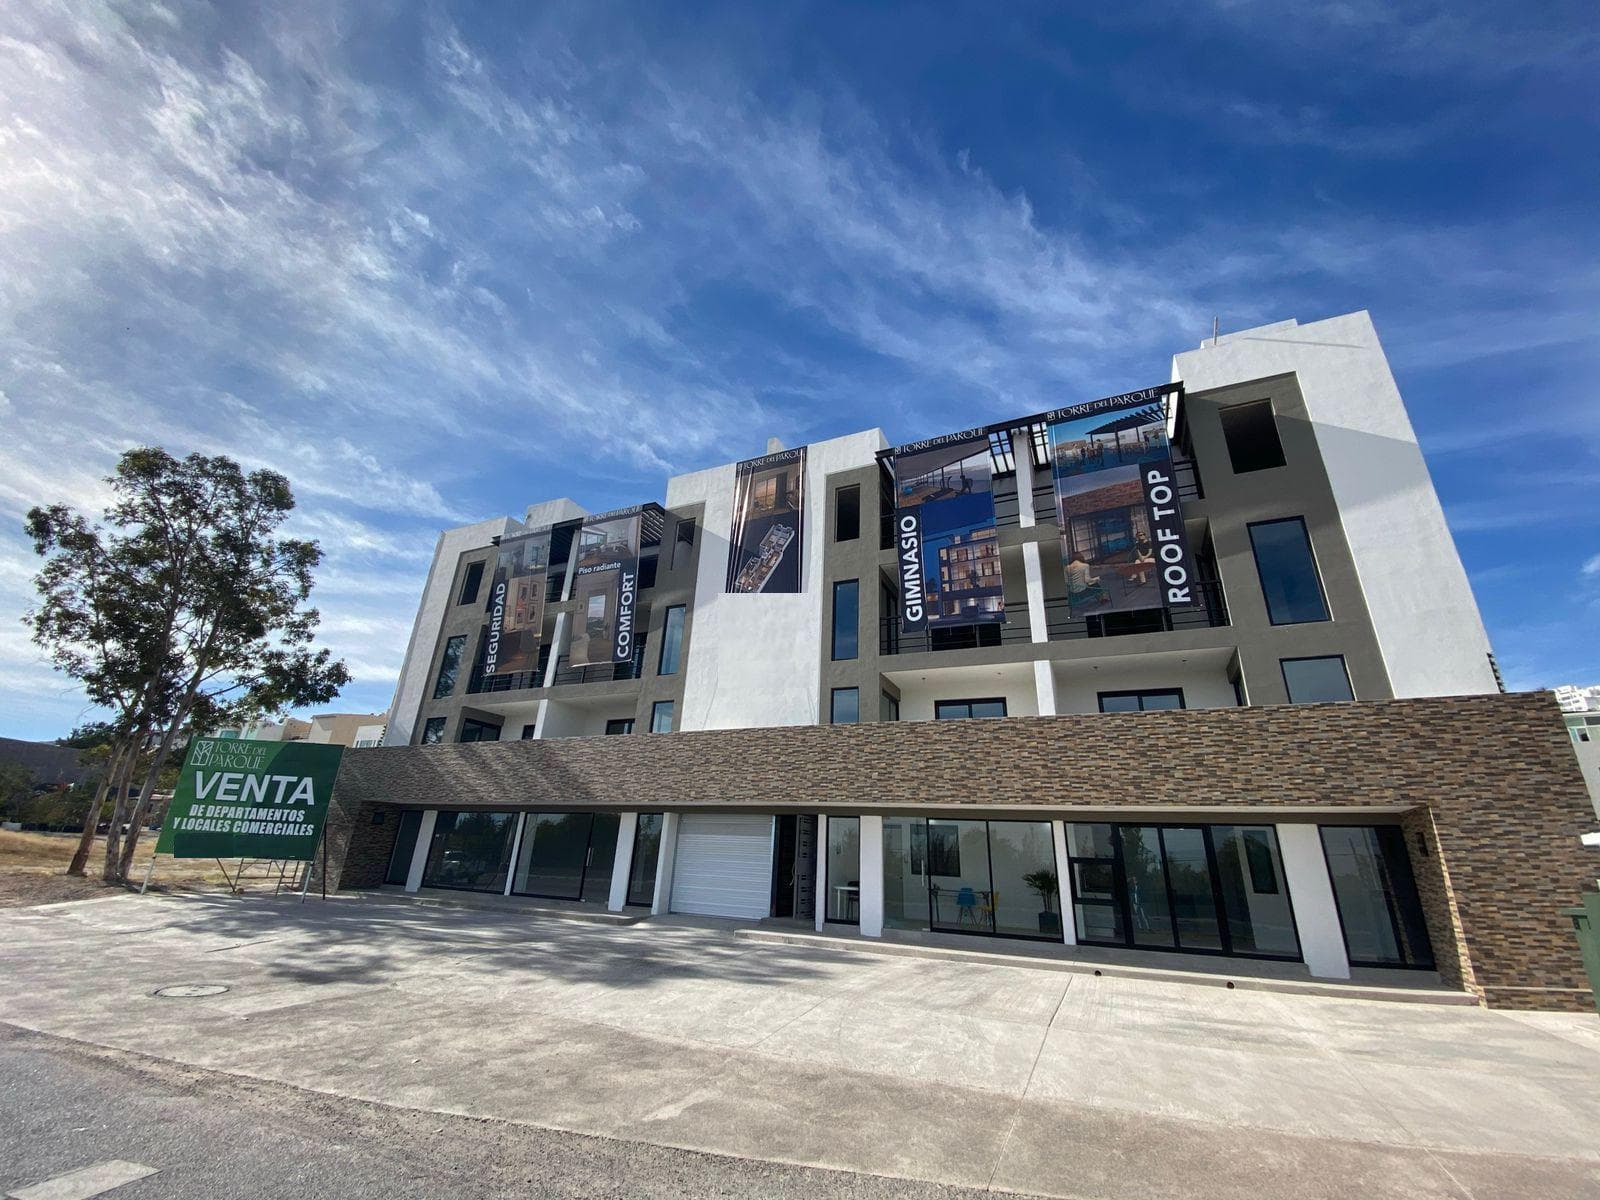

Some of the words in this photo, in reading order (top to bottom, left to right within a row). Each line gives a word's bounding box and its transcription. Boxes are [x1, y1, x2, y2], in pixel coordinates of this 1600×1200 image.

[1109, 387, 1159, 407] PARQUE
[1147, 469, 1175, 521] TOP
[578, 566, 592, 575] Piso
[593, 561, 621, 572] radiante
[900, 515, 923, 622] GIMNASIO
[1156, 528, 1192, 604] ROOF
[485, 582, 506, 674] SEGURIDAD
[617, 572, 634, 658] COMFORT
[208, 753, 265, 769] PARQUE
[214, 741, 252, 754] TORRE
[195, 771, 315, 806] VENTA
[173, 817, 181, 830] Y
[181, 818, 231, 833] LOCALES
[233, 821, 314, 836] COMERCIALES
[189, 804, 205, 817] DE
[206, 805, 305, 822] DEPARTAMENTOS
